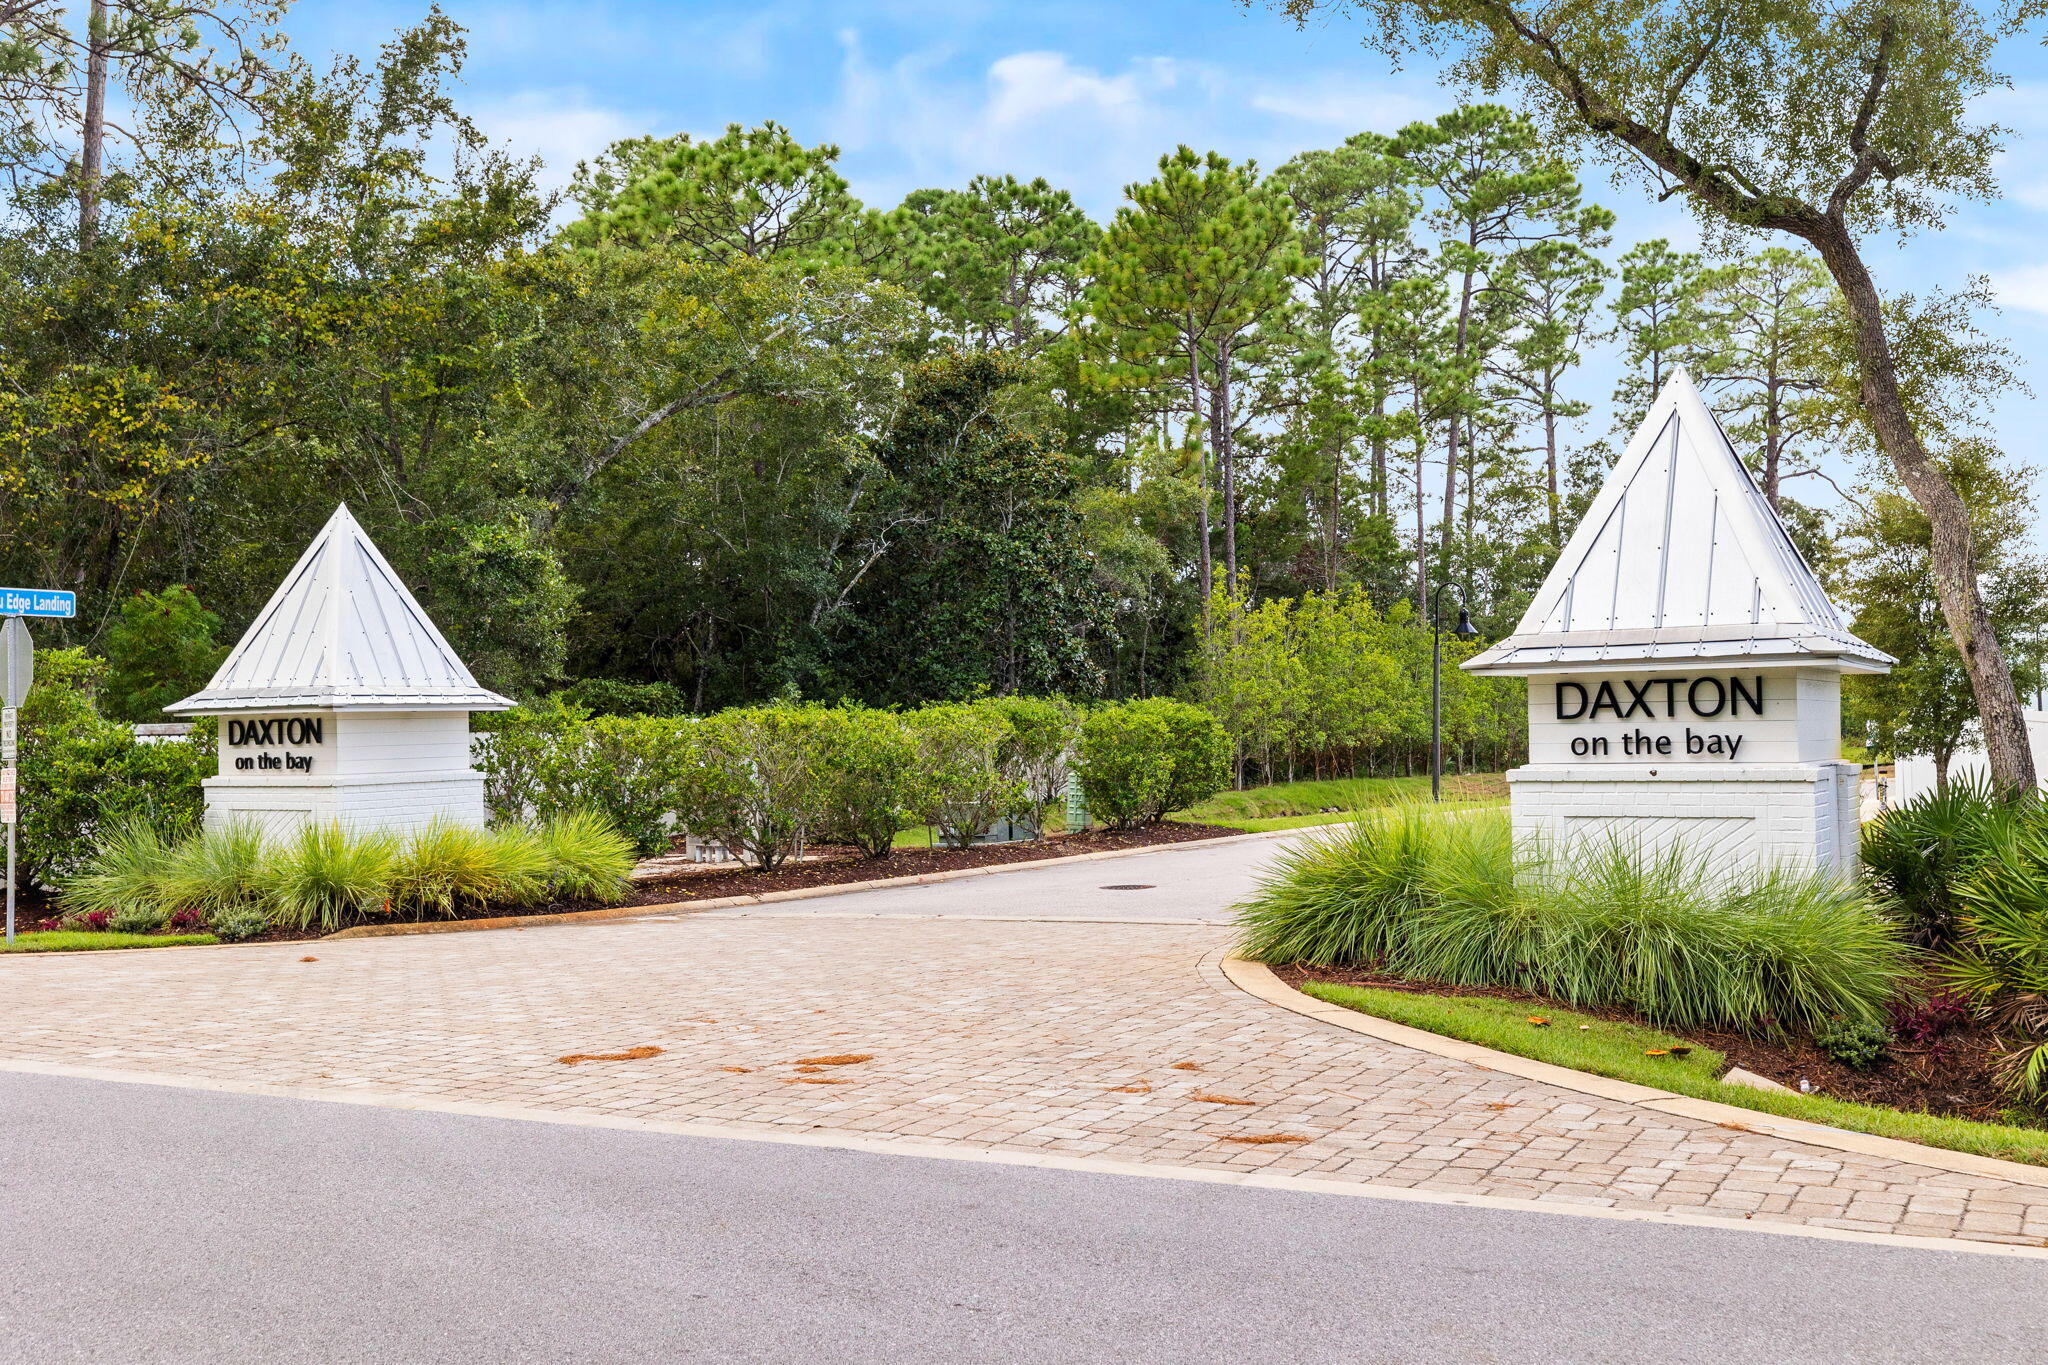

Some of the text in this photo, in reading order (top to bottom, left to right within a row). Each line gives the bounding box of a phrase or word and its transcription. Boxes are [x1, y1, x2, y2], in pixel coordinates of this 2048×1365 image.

[7, 593, 31, 613] Edge
[33, 594, 71, 616] Landing
[1555, 676, 1763, 719] DAXTON
[228, 717, 322, 746] DAXTON
[1570, 728, 1743, 760] on the bay
[235, 752, 312, 773] on the bay
